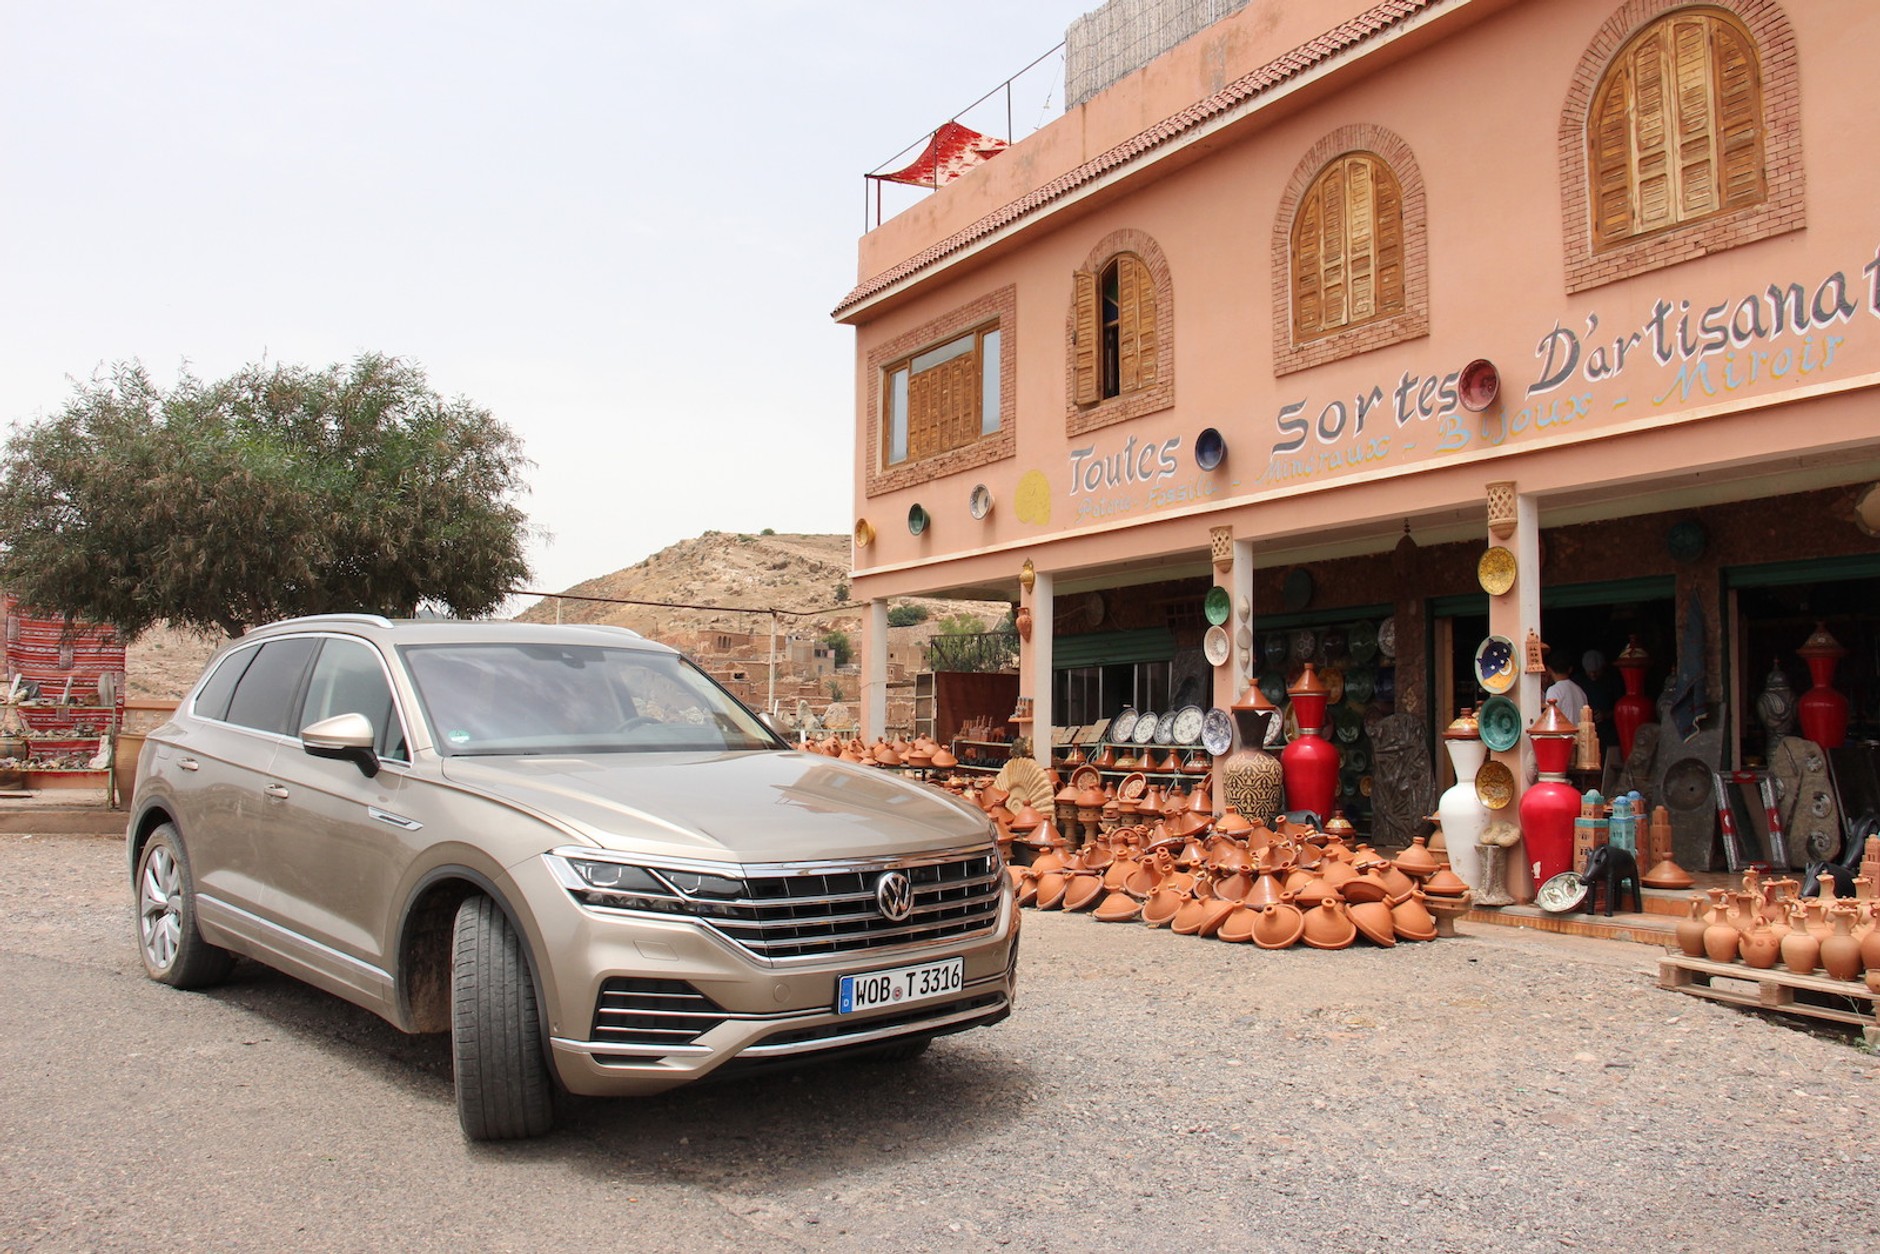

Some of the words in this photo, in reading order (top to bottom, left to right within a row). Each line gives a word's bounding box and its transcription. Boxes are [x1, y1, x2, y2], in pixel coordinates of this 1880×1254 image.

[1069, 435, 1182, 496] Toutes
[1270, 368, 1461, 460] Sortes
[1435, 392, 1592, 452] Bijoux
[1652, 334, 1845, 406] Miroir
[855, 976, 891, 1006] WOB
[906, 972, 916, 997] T
[920, 963, 960, 994] 3316
